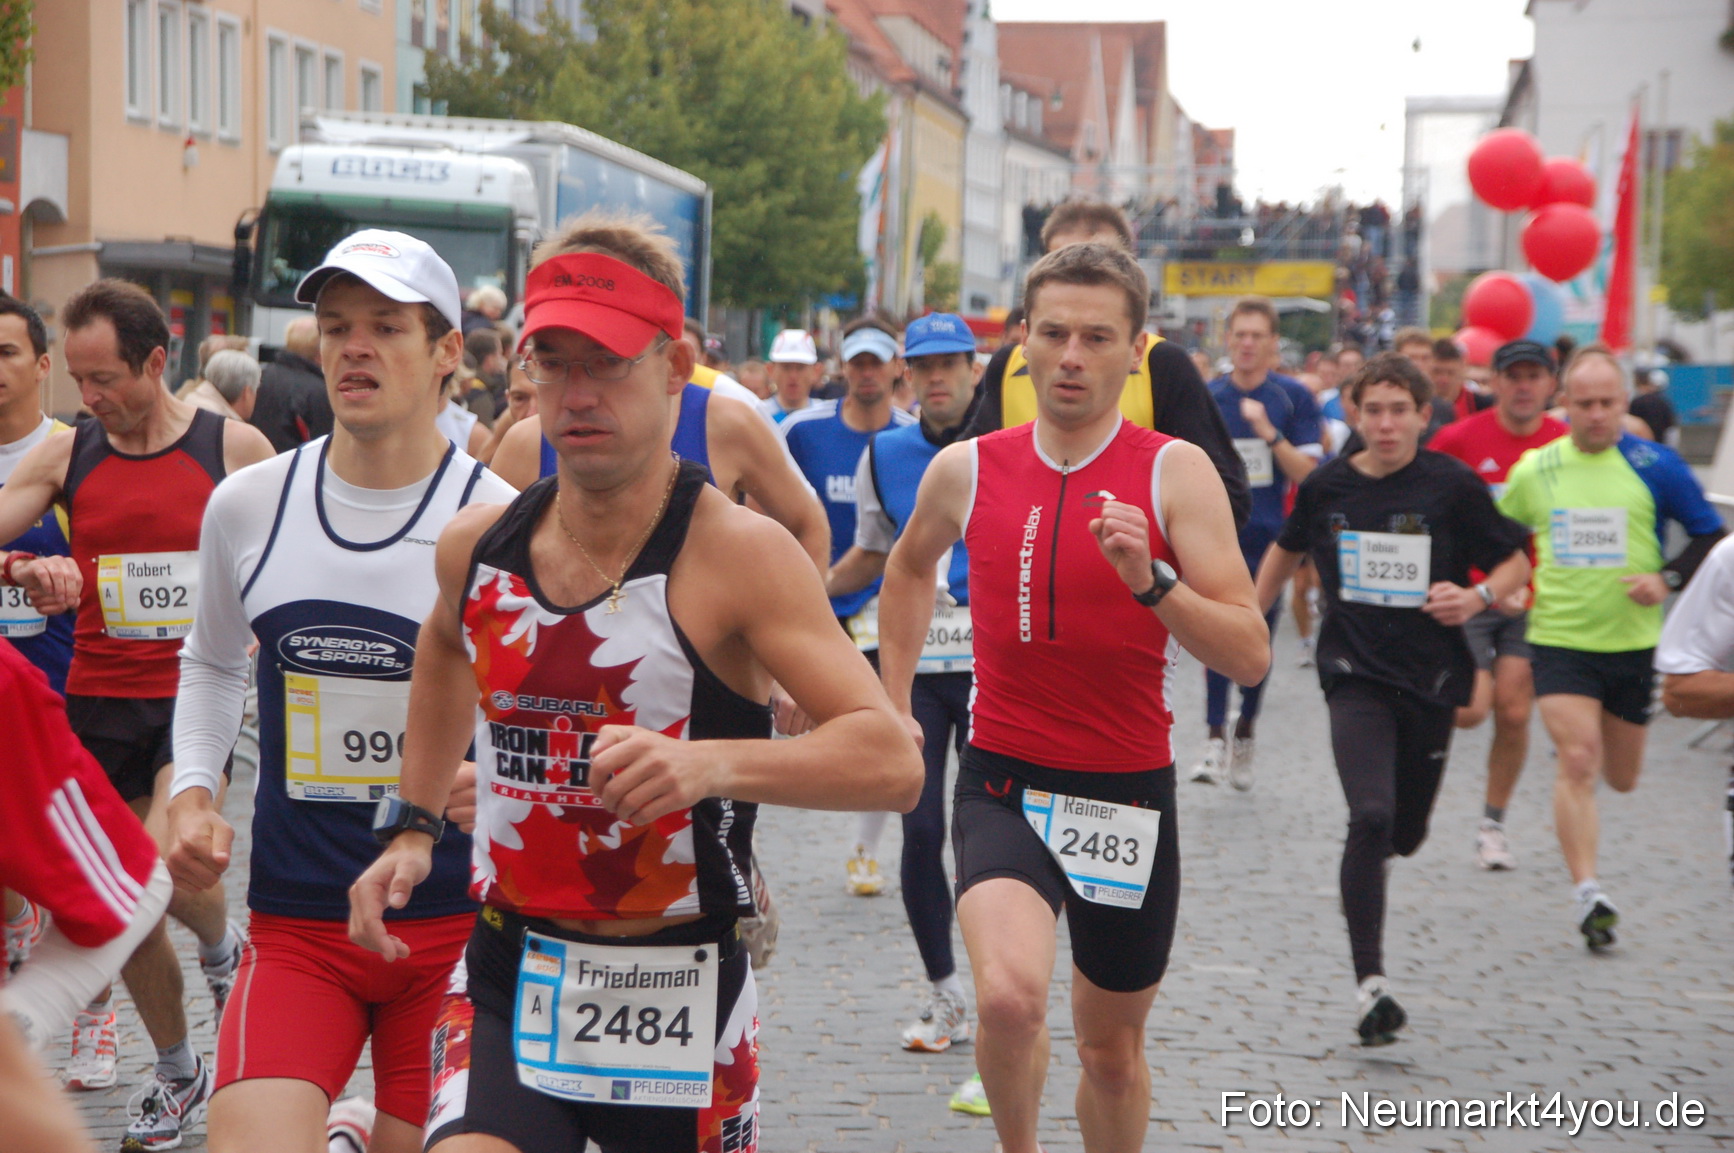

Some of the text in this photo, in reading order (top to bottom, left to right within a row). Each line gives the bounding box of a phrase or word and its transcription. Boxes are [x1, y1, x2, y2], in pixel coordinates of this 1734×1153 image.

[577, 274, 615, 291] 2008
[127, 562, 171, 577] Robert
[1018, 505, 1043, 643] contractrelax
[1366, 560, 1419, 581] 3239
[105, 587, 111, 599] A
[139, 586, 188, 609] 692
[288, 635, 378, 651] SYNERGY
[320, 650, 396, 668] SPORTS
[517, 694, 605, 716] SUBARU
[492, 784, 602, 805] TRIATHLO
[1063, 795, 1118, 820] Rainer
[1060, 828, 1140, 867] 2483
[578, 959, 700, 989] Friedeman
[531, 994, 542, 1015] A
[574, 1002, 694, 1047] 2484
[633, 1080, 709, 1096] PFLEIDERER
